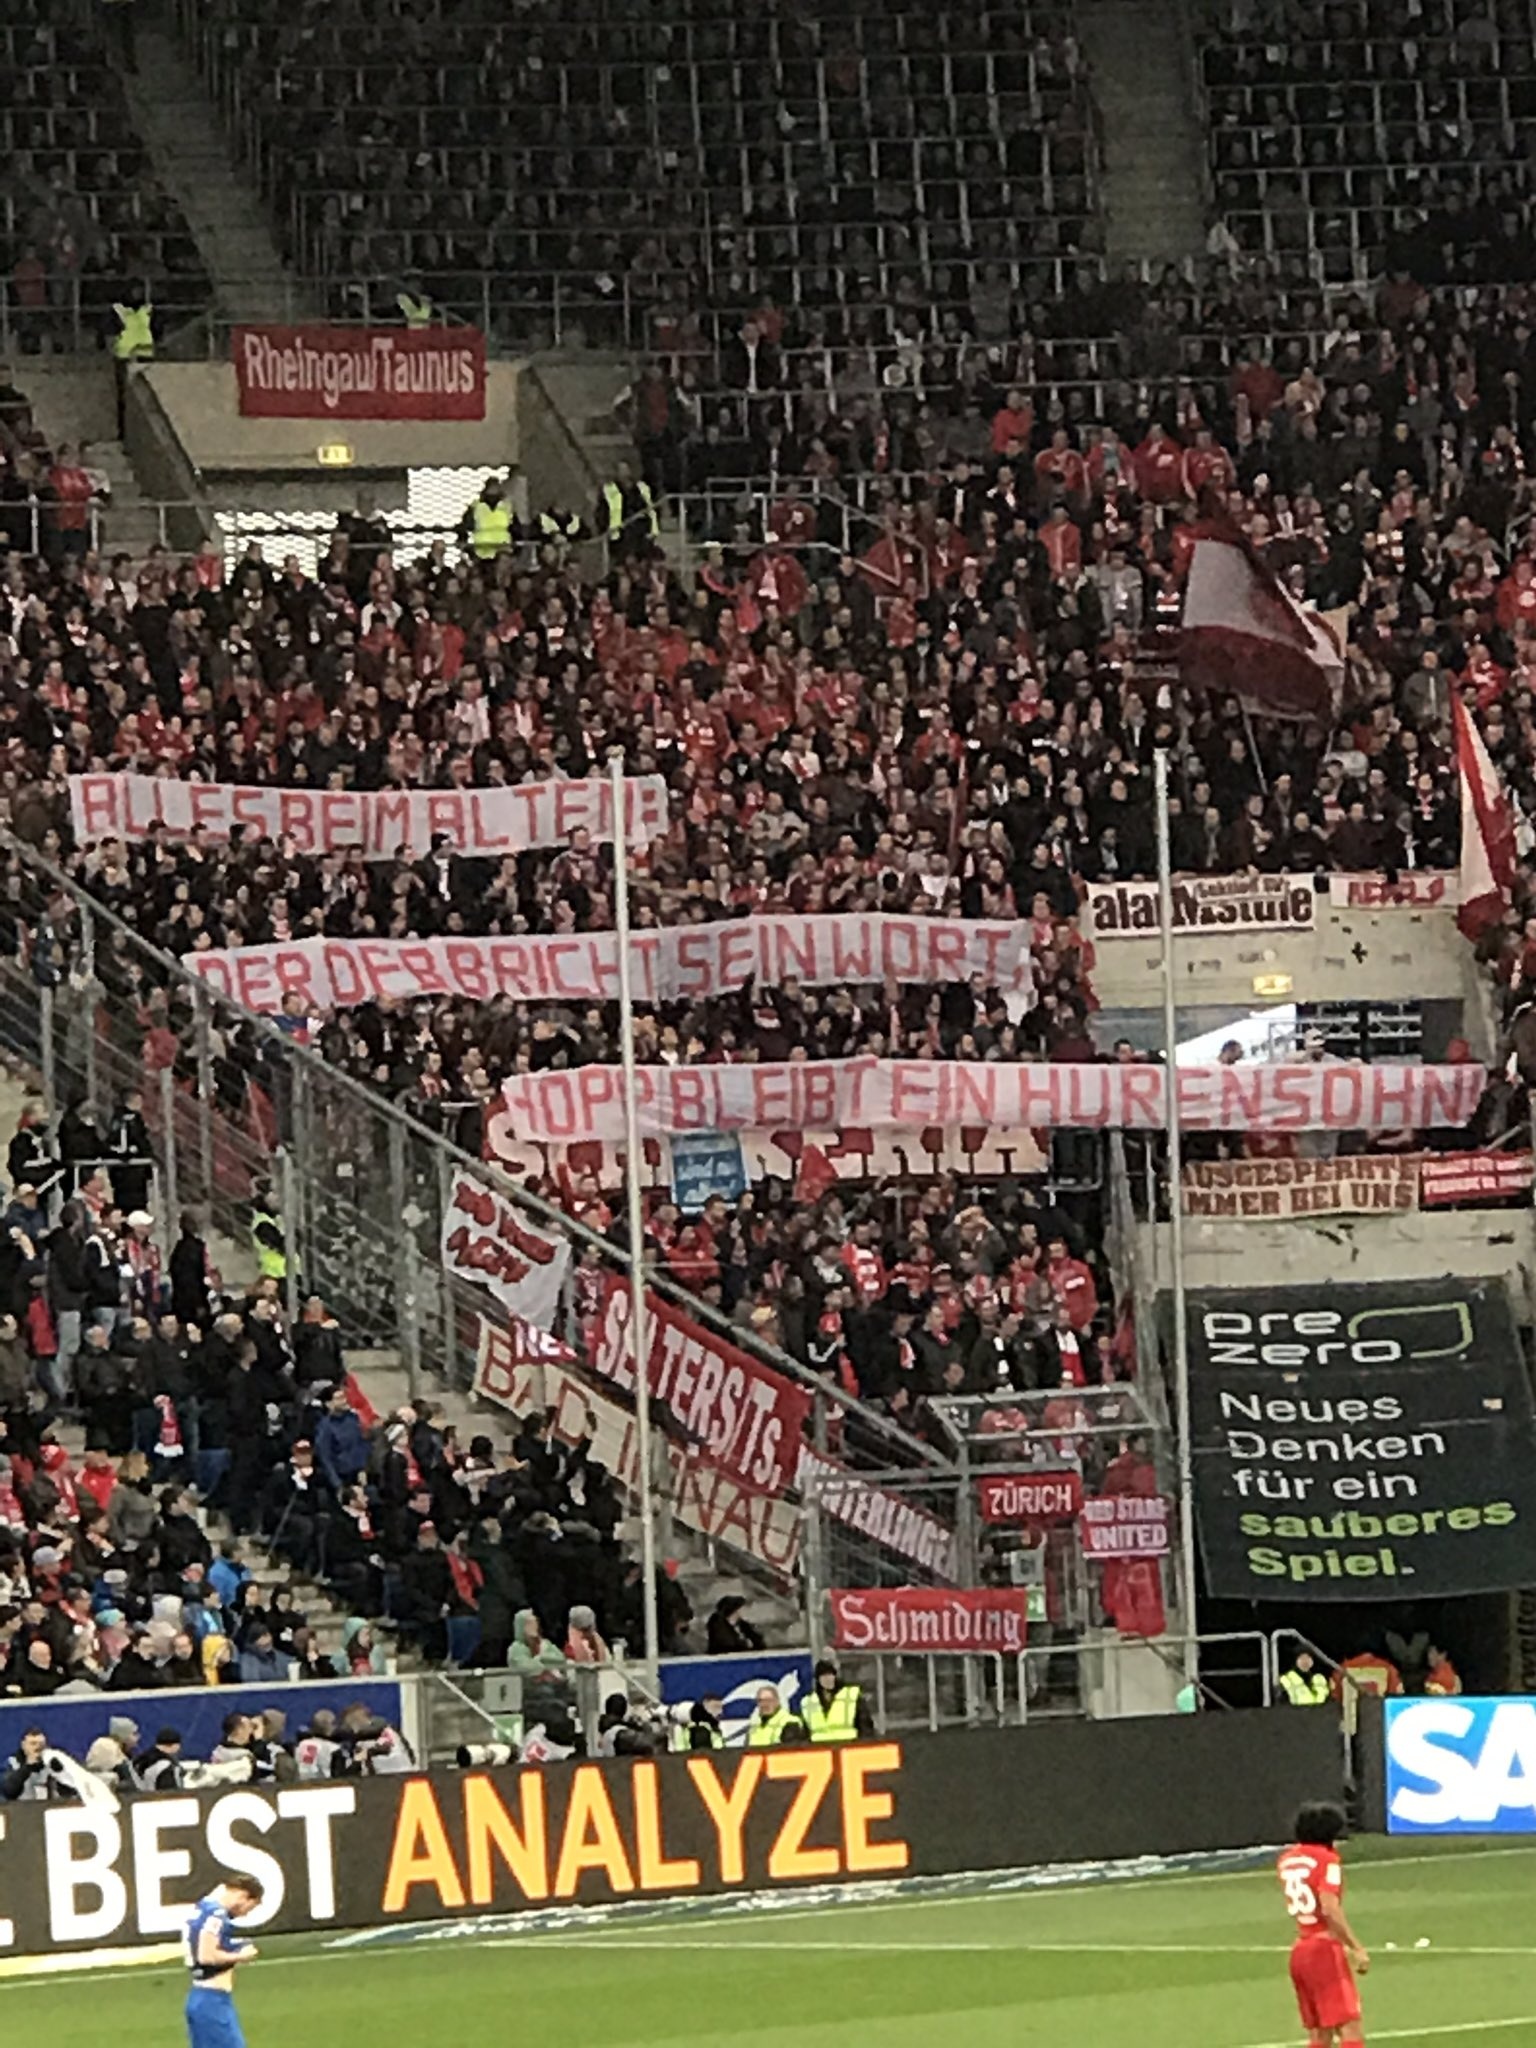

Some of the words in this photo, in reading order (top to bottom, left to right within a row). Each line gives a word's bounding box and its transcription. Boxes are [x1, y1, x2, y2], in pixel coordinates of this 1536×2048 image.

[244, 333, 475, 408] Rheingau/Taunus
[82, 777, 268, 843] ALLES
[280, 792, 411, 851] BEIM
[429, 779, 658, 848] ALTEN:
[197, 951, 320, 1013] DER
[323, 943, 448, 1004] DFB
[447, 939, 660, 998] BRICHT
[678, 923, 816, 998] SEIN
[670, 1055, 878, 1129] BLEIBT
[891, 1062, 996, 1124] EIN
[1291, 1185, 1342, 1212] BEI
[1352, 1183, 1413, 1208] UNS
[1203, 1311, 1342, 1340] pre
[1208, 1340, 1402, 1365] zero
[1220, 1392, 1403, 1423] Neues
[1227, 1430, 1446, 1461] Denken
[987, 1481, 1072, 1515] ZÜRICH
[1232, 1469, 1314, 1499] für
[1332, 1470, 1418, 1500] ein
[1091, 1524, 1167, 1550] UNITED
[1239, 1502, 1517, 1539] sauberes
[1247, 1547, 1415, 1581] Spiel.
[840, 1594, 1021, 1652] Schmiding
[44, 1786, 356, 1943] BEST
[383, 1743, 910, 1912] ANALYZE
